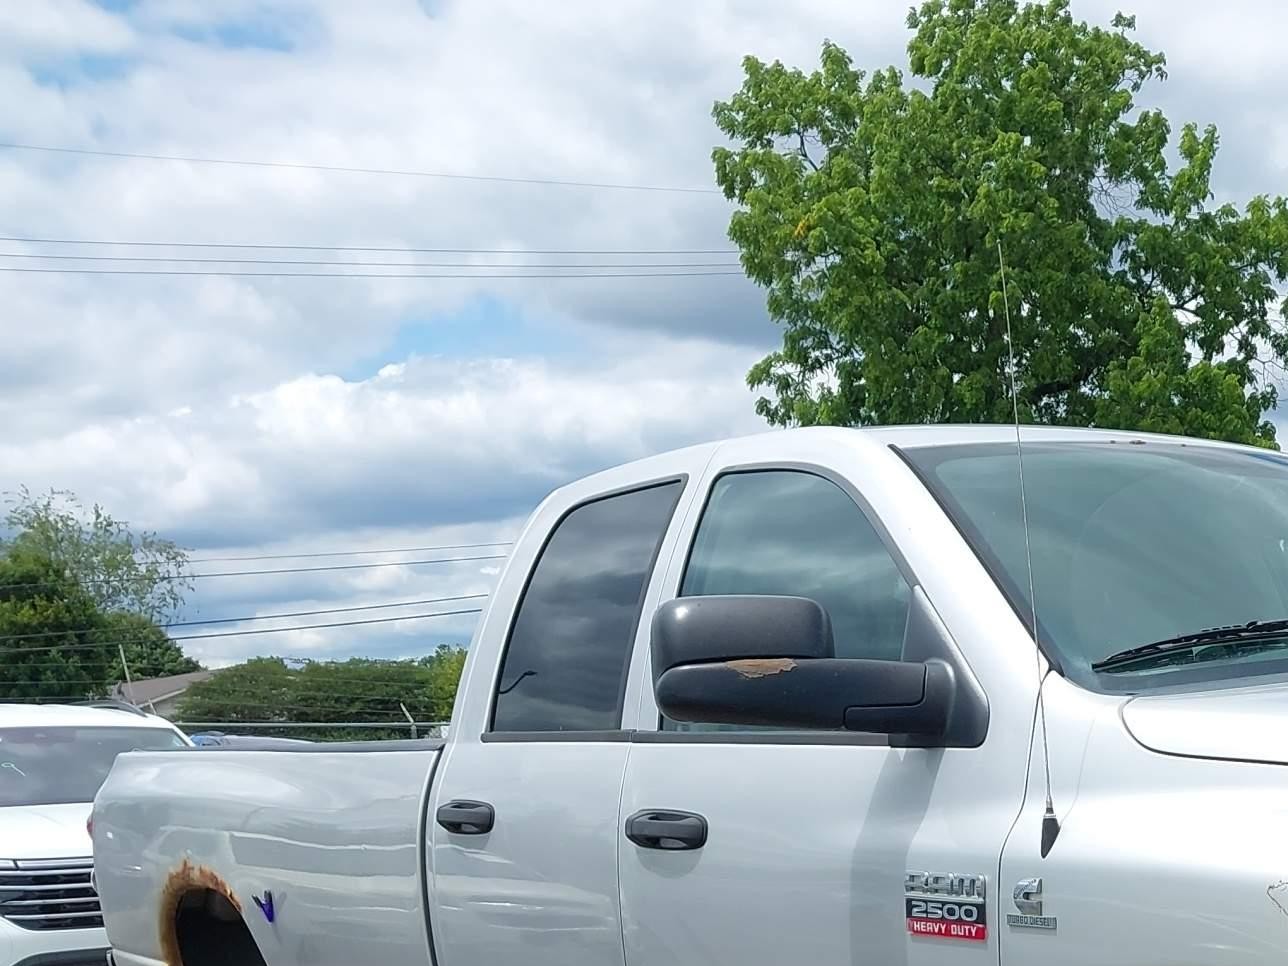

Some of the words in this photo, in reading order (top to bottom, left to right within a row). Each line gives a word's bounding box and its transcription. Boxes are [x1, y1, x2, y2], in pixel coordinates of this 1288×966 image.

[911, 900, 978, 922] 2500
[913, 920, 947, 935] HEAVY
[951, 923, 977, 937] DUTY
